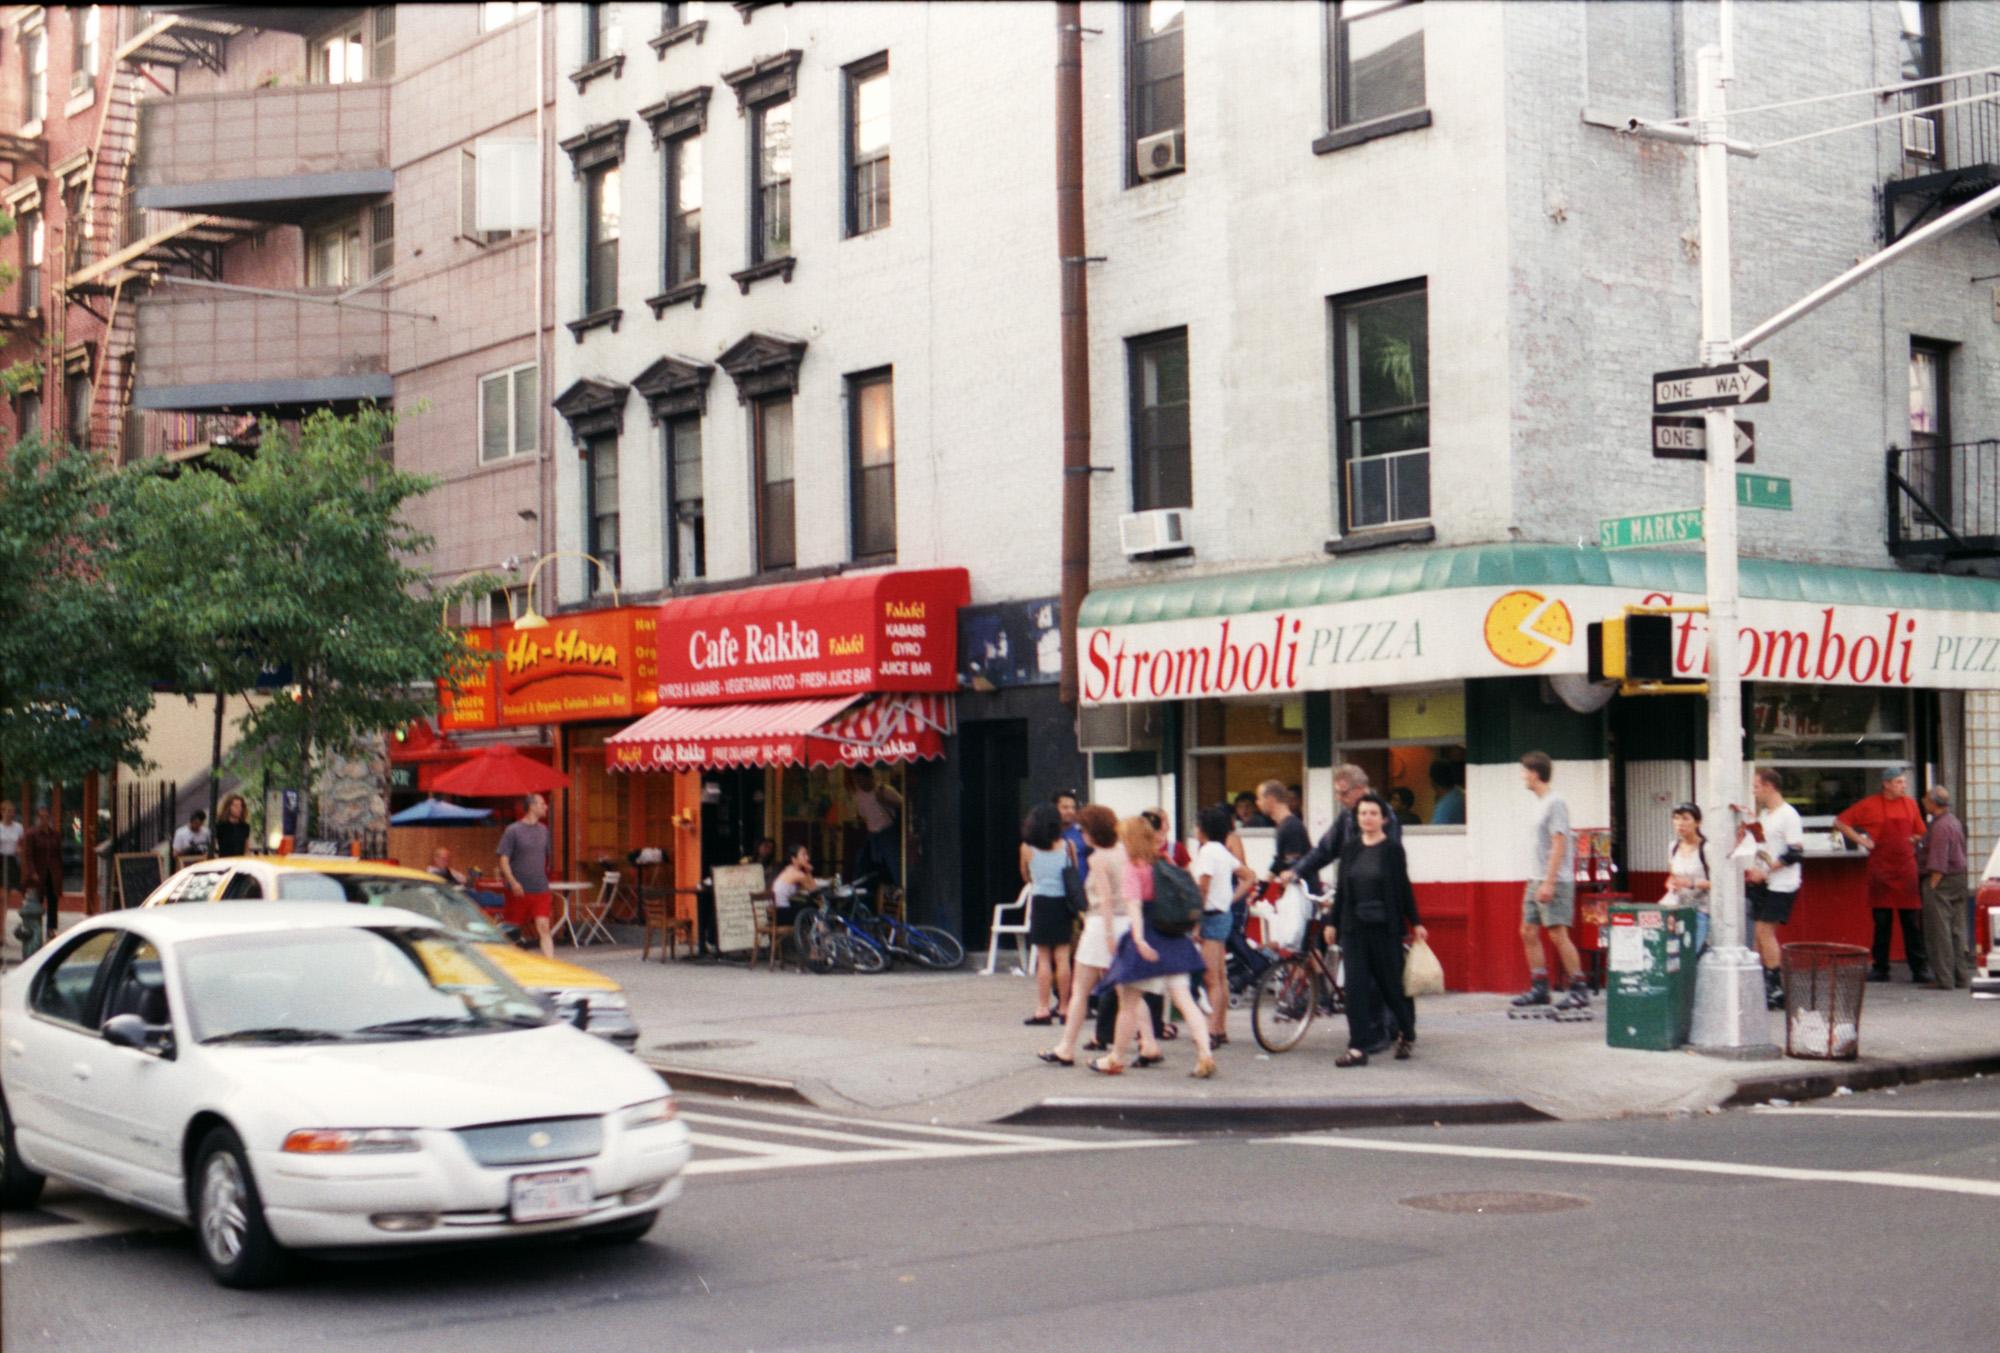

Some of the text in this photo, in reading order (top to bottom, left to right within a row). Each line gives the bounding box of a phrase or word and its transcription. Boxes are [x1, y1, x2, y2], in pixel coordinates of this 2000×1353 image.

[1661, 375, 1751, 401] ONE WAY
[1661, 428, 1693, 447] ONE
[1602, 521, 1619, 546] ST
[1630, 513, 1687, 543] MARKS
[885, 602, 926, 618] Falafel
[885, 623, 926, 638] KABABS
[505, 629, 618, 675] Ha-Hava
[689, 620, 864, 670] Cafe Rakka Falafel
[892, 643, 921, 656] GYRO
[1931, 635, 2000, 672] PIZZ
[879, 661, 931, 676] JUICE BAR
[1085, 613, 1424, 701] Stromboli PIZZA
[691, 681, 720, 697] KABABS
[724, 676, 771, 694] VEGETARIAN
[772, 674, 795, 690] FOOD
[800, 671, 828, 689] FRESH
[828, 668, 852, 686] JUICE
[853, 667, 872, 685] BAR
[652, 744, 673, 761] Cafe
[676, 743, 704, 761] Rakka
[839, 738, 916, 759] Cafe Rakka
